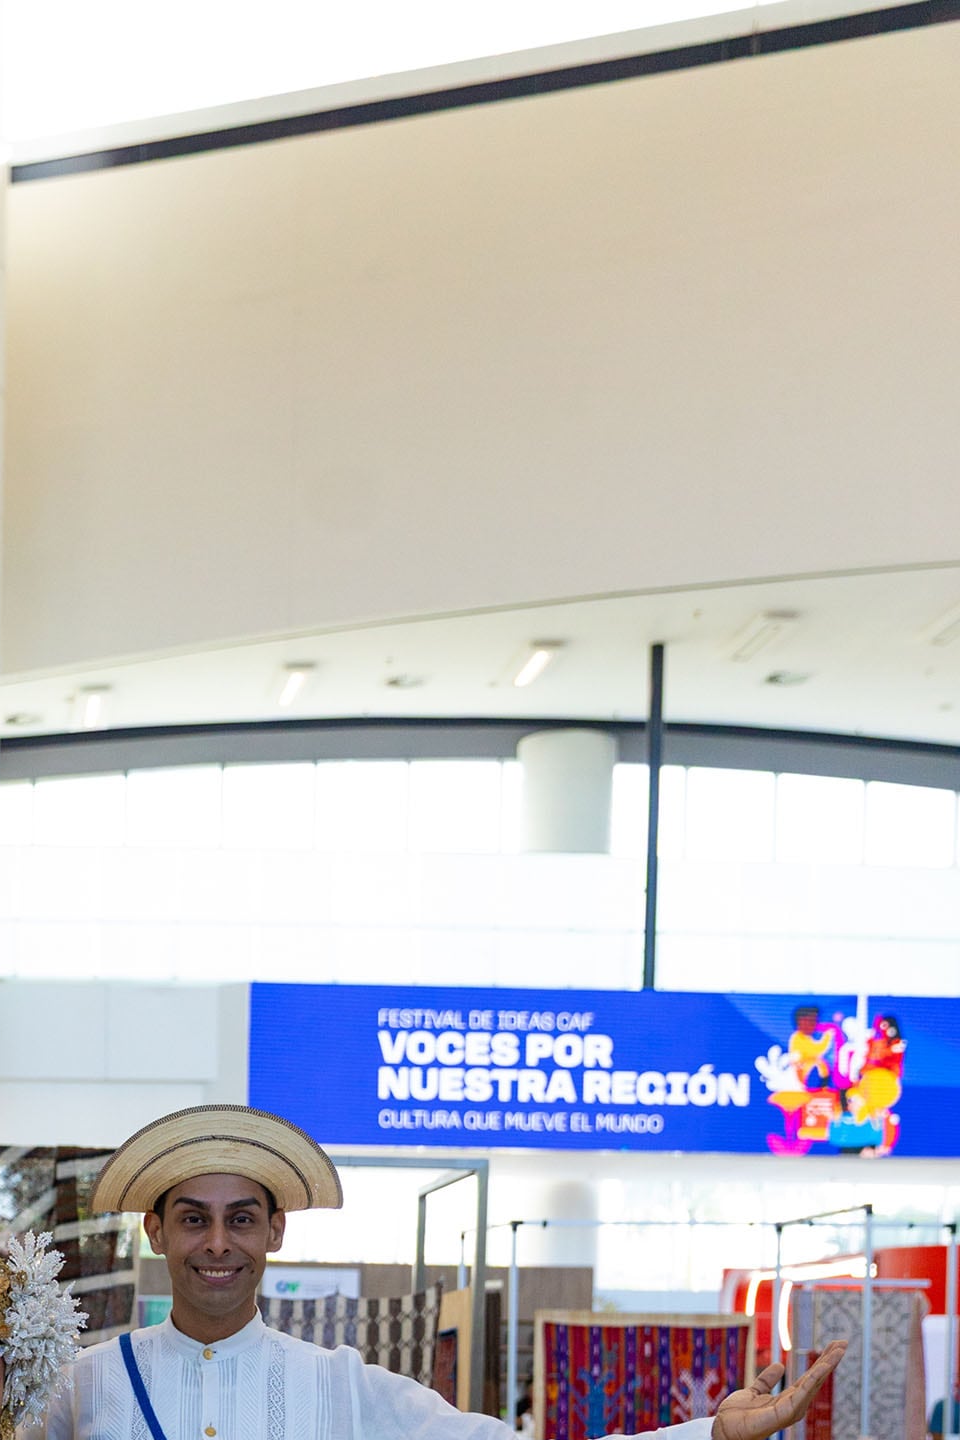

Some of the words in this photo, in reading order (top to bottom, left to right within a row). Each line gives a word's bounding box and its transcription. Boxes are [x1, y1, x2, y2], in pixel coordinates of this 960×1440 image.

[378, 1008, 466, 1029] FESTIVAL
[469, 1010, 495, 1030] DE
[498, 1010, 556, 1031] IDEAS
[556, 1011, 595, 1032] CAF
[377, 1030, 520, 1066] VOCES
[525, 1033, 614, 1068] POR
[377, 1066, 577, 1103] NUESTRA
[583, 1063, 751, 1107] REGIÓN
[378, 1108, 462, 1129] CULTURA
[464, 1110, 503, 1131] QUE
[504, 1111, 568, 1132] MUEVE
[570, 1112, 593, 1132] EL
[595, 1112, 665, 1134] MUNDO
